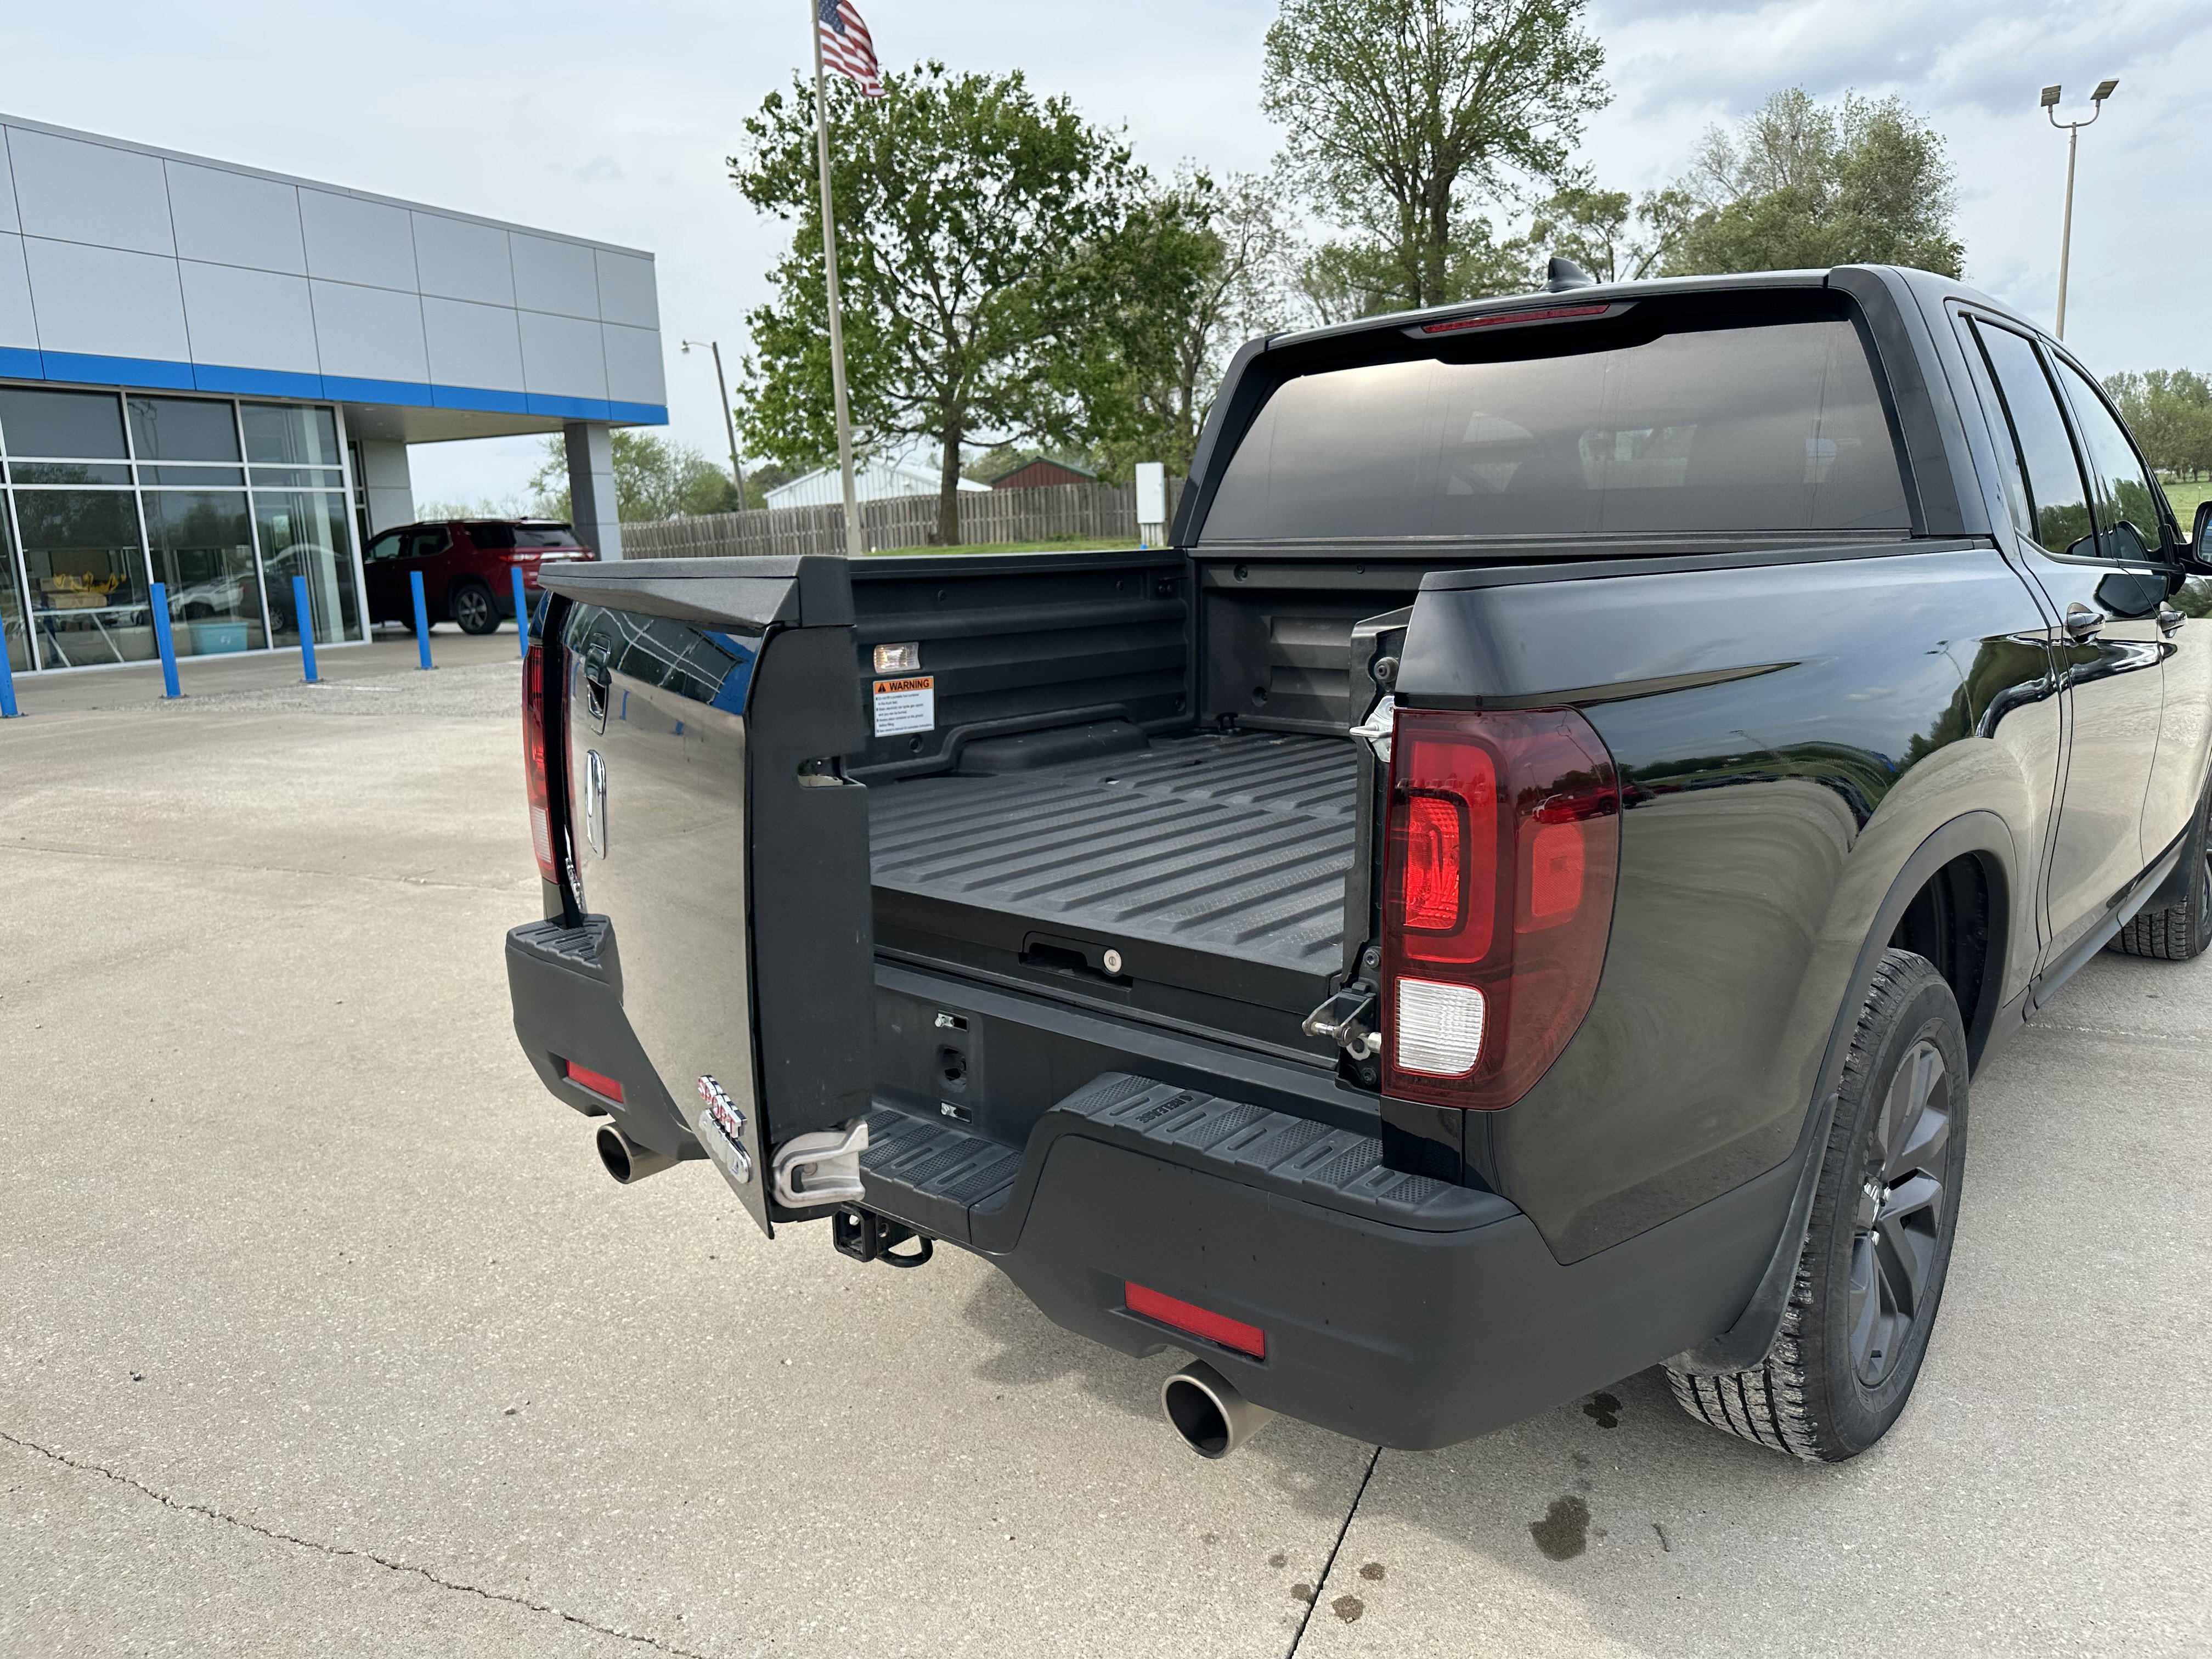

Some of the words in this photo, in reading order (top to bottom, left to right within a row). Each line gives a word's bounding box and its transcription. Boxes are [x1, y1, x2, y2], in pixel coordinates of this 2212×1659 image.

[889, 679, 929, 691] WARNING
[698, 1075, 747, 1138] SPORT
[1135, 1098, 1186, 1124] RELEASE
